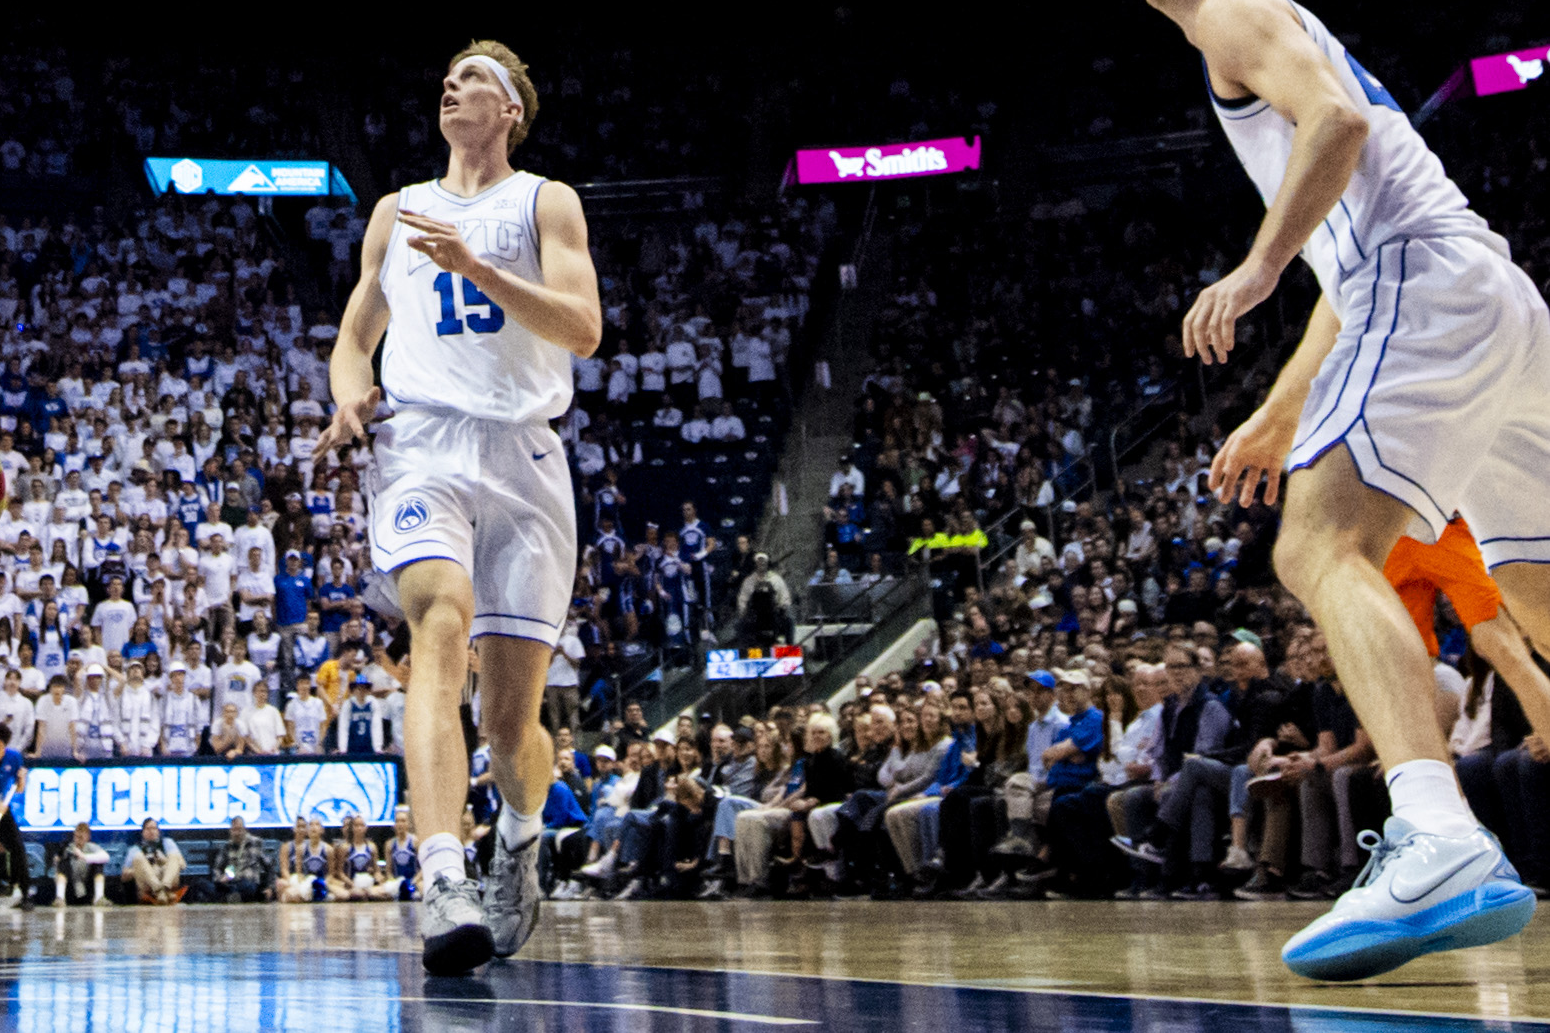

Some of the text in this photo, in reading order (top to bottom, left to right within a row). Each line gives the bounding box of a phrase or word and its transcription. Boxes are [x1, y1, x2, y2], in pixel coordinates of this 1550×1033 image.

[865, 146, 948, 177] Smith's
[433, 271, 505, 337] 15
[23, 766, 262, 826] GO COUGS
